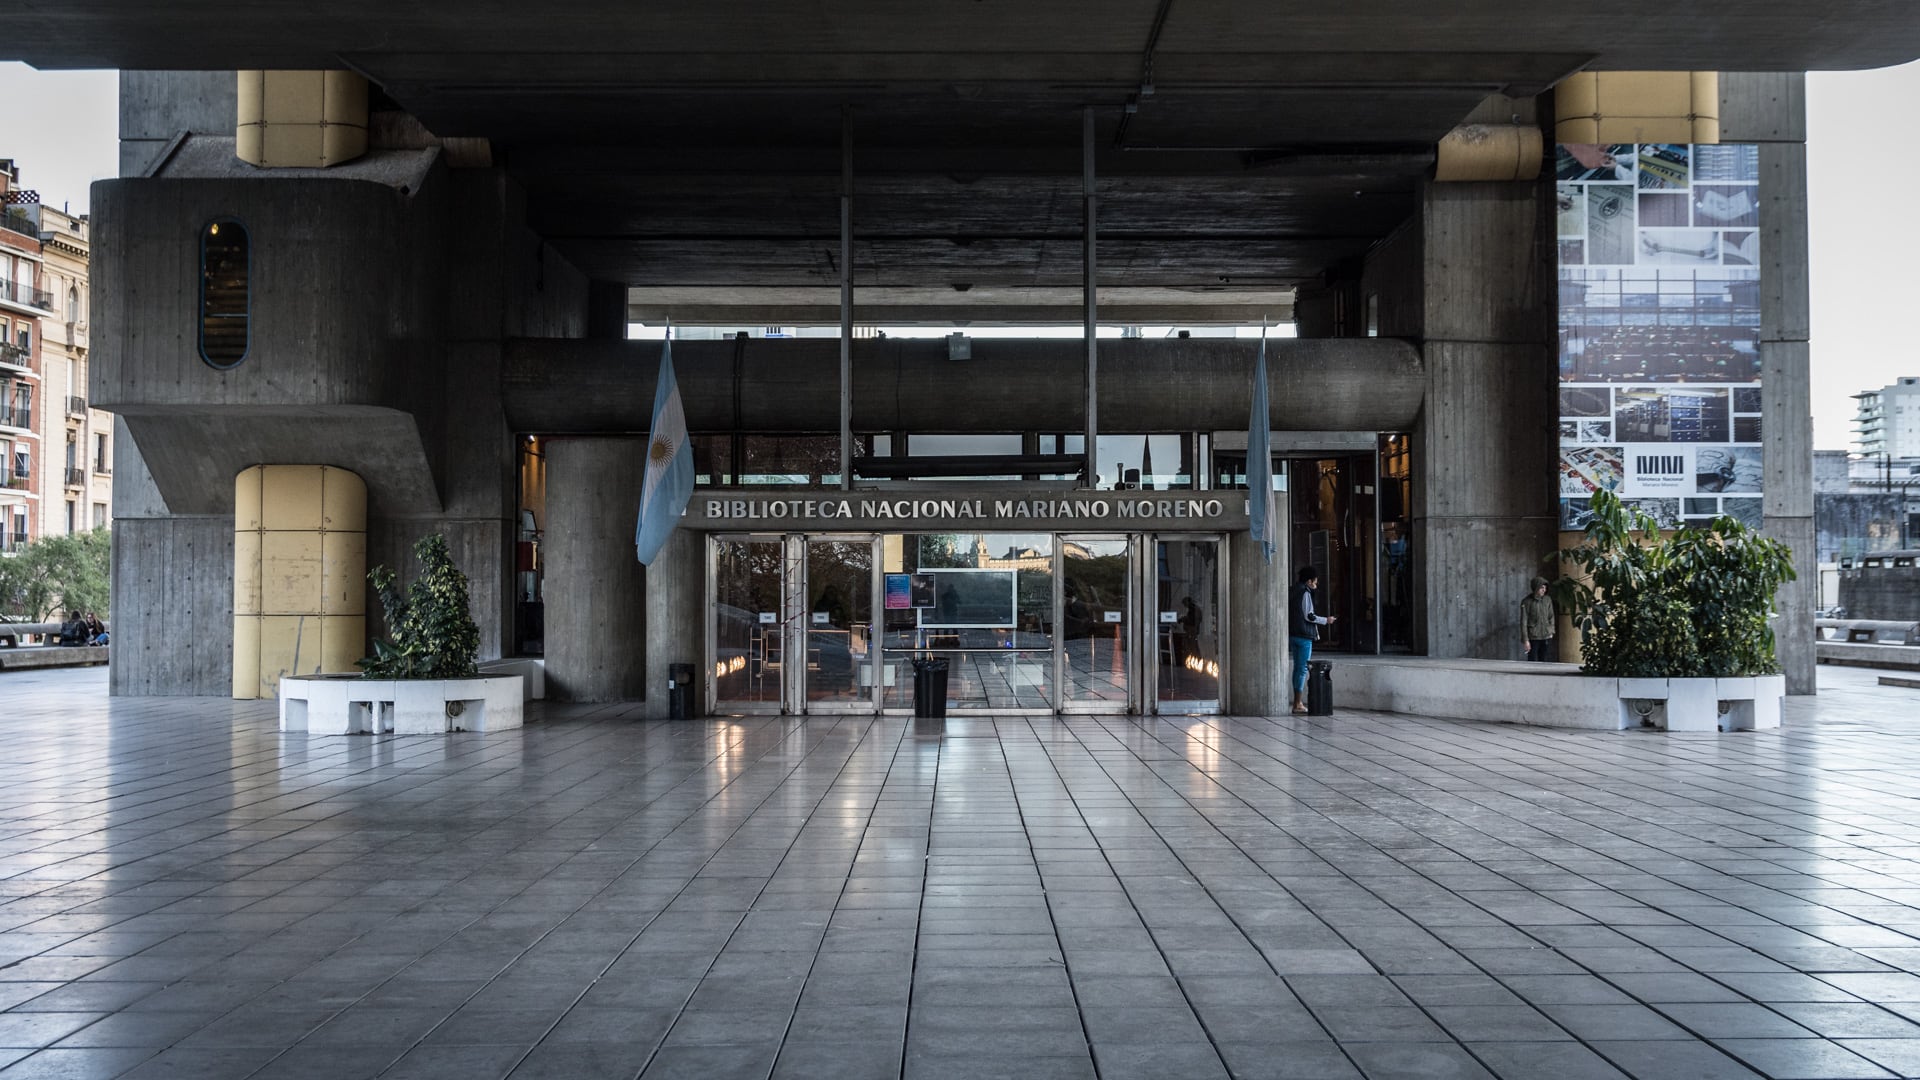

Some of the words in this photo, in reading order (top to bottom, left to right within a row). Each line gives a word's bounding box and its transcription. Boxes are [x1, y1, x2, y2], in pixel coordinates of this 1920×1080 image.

[706, 500, 852, 518] BIBLIOTECA
[860, 500, 987, 518] NACIONAL
[995, 500, 1110, 518] MARIANO
[1117, 500, 1223, 518] MORENO
